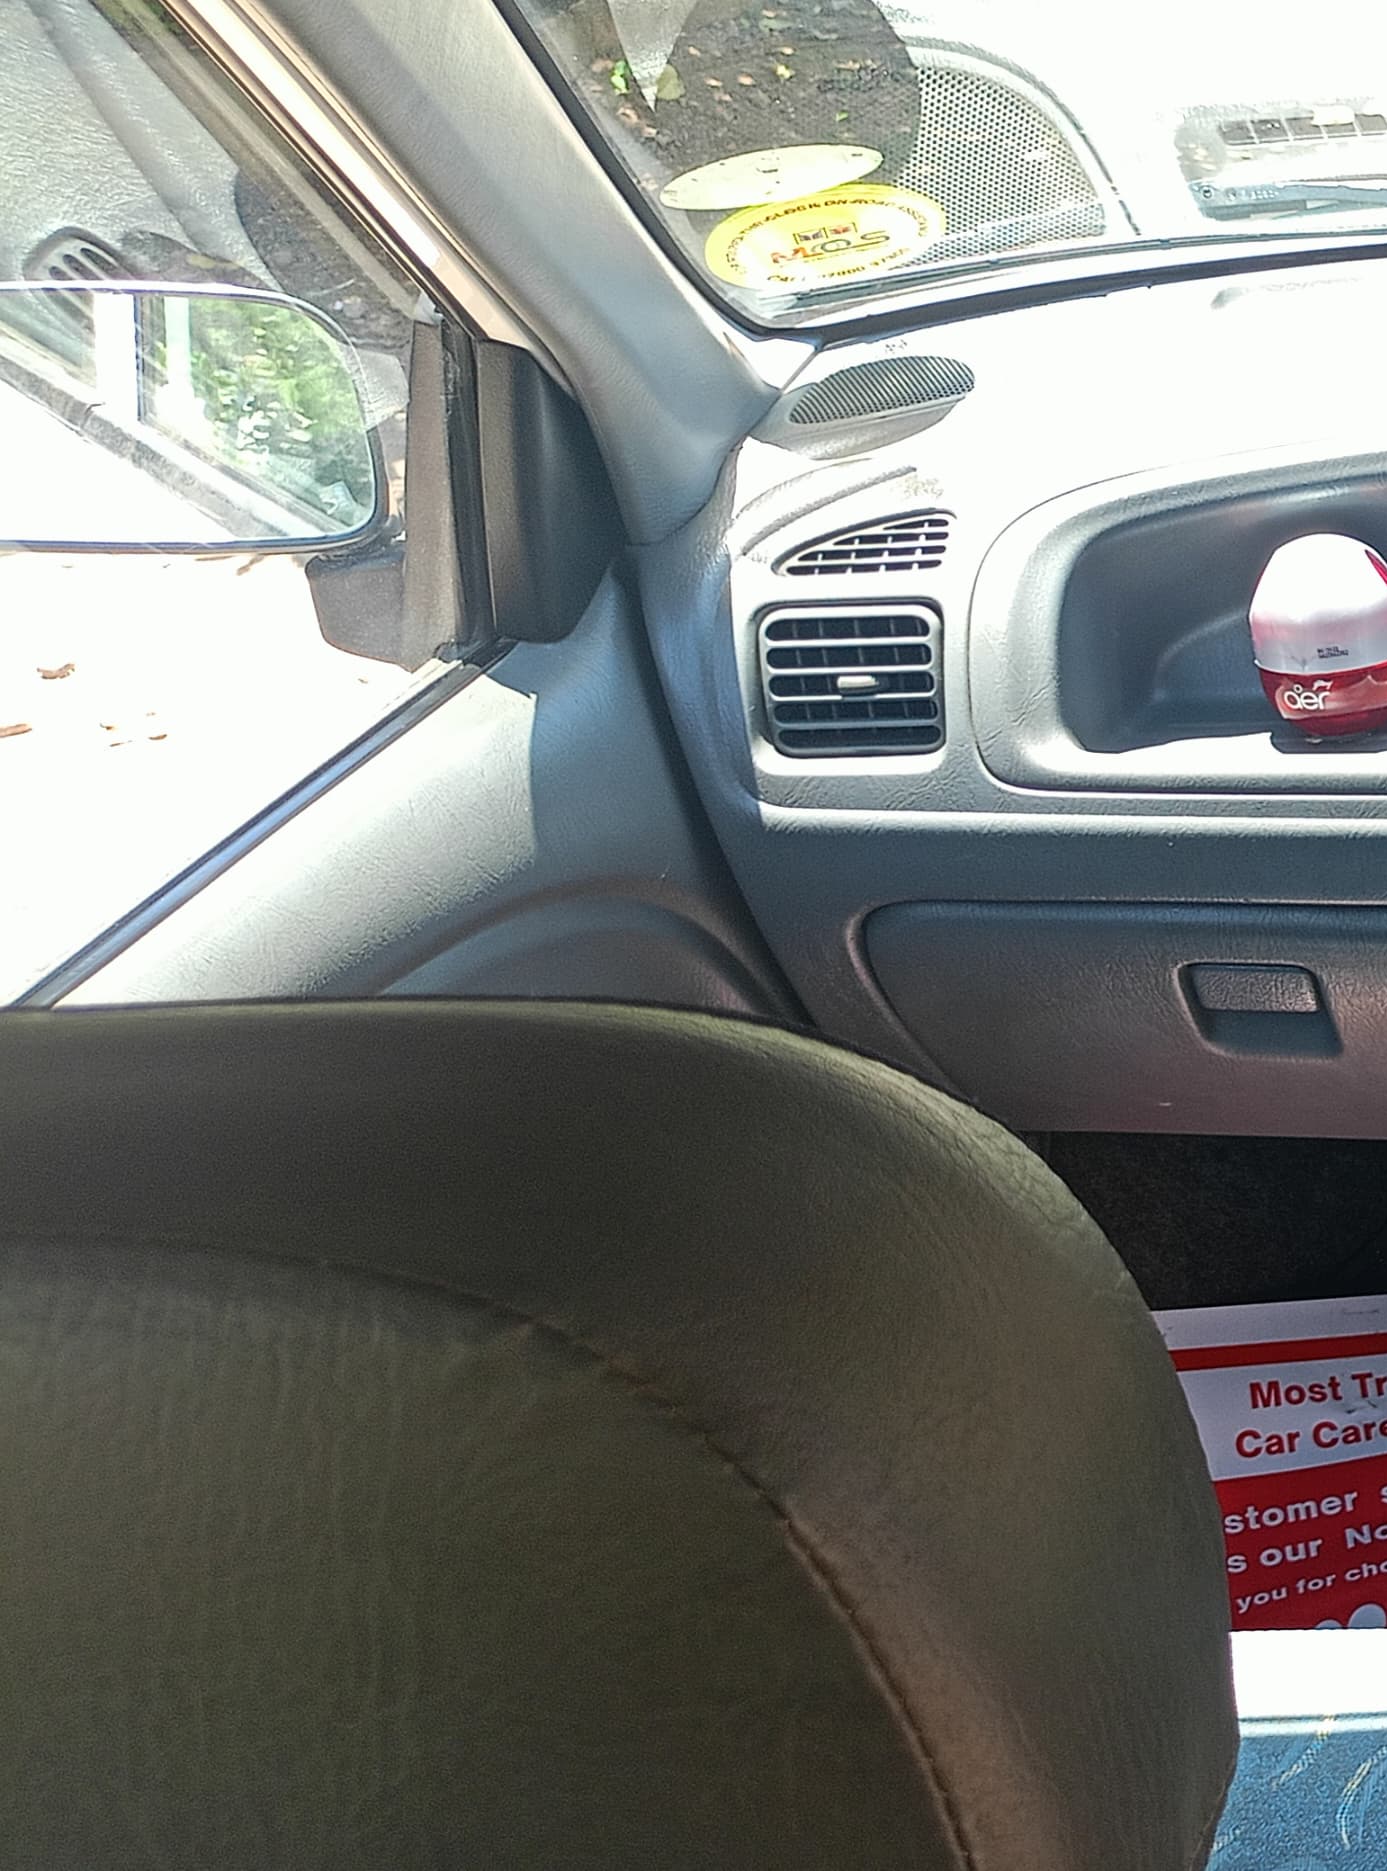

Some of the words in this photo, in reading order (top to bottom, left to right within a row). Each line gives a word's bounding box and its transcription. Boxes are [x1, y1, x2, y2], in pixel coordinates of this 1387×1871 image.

[1249, 1376, 1343, 1409] Most
[1235, 1429, 1300, 1458] Car
[1224, 1490, 1358, 1534] stomer
[1227, 1555, 1247, 1574] s
[1260, 1537, 1323, 1568] our
[1237, 1585, 1287, 1613] you
[1296, 1575, 1336, 1595] for
